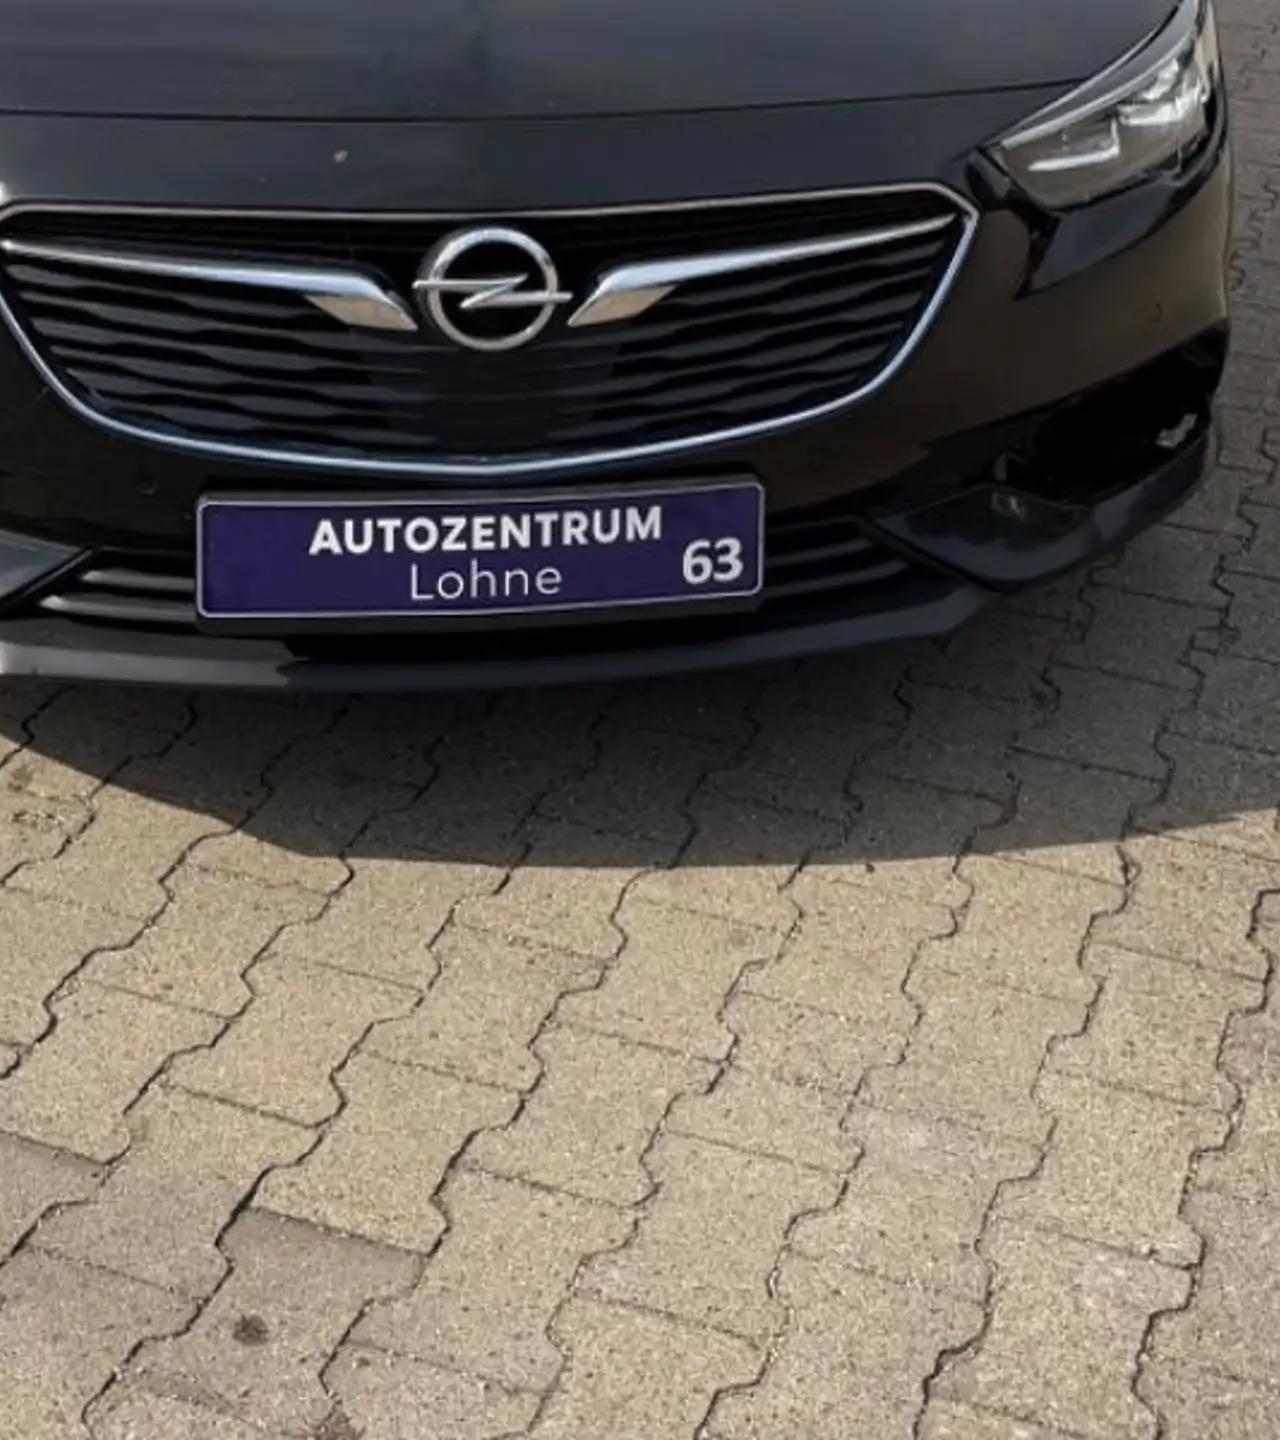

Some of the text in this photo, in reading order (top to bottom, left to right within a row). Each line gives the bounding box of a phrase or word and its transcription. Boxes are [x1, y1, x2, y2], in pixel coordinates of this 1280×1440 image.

[308, 506, 663, 556] AUTOZENTRUM
[410, 559, 563, 602] Lohne
[682, 537, 744, 586] 63
